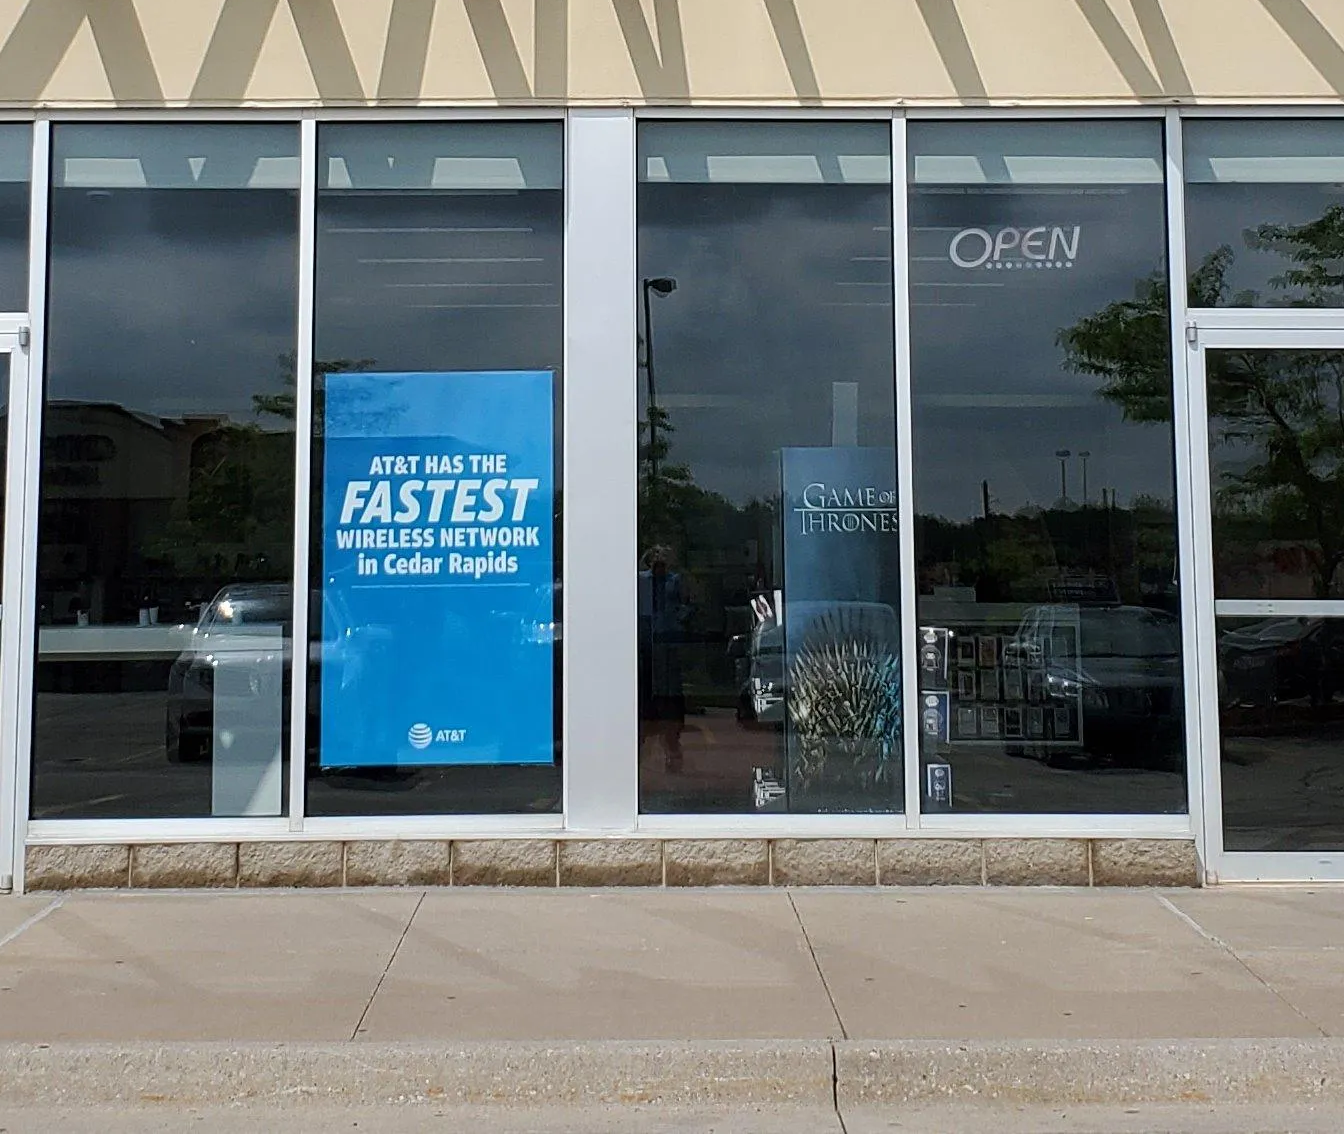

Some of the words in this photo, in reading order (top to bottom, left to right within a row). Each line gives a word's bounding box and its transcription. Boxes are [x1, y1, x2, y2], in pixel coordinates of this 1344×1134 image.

[949, 226, 1081, 268] OPEN
[369, 455, 421, 475] AT&T
[425, 455, 464, 474] HAS
[469, 454, 507, 474] THE
[339, 478, 540, 524] FASTEST
[803, 482, 876, 509] GAME
[878, 490, 897, 504] OF
[799, 510, 898, 536] THRONES
[336, 527, 435, 550] WIRELESS
[440, 526, 540, 548] NETWORK
[358, 553, 378, 576] in
[384, 551, 443, 575] Cedar
[449, 550, 519, 580] Rapids
[436, 729, 466, 742] AT&T
